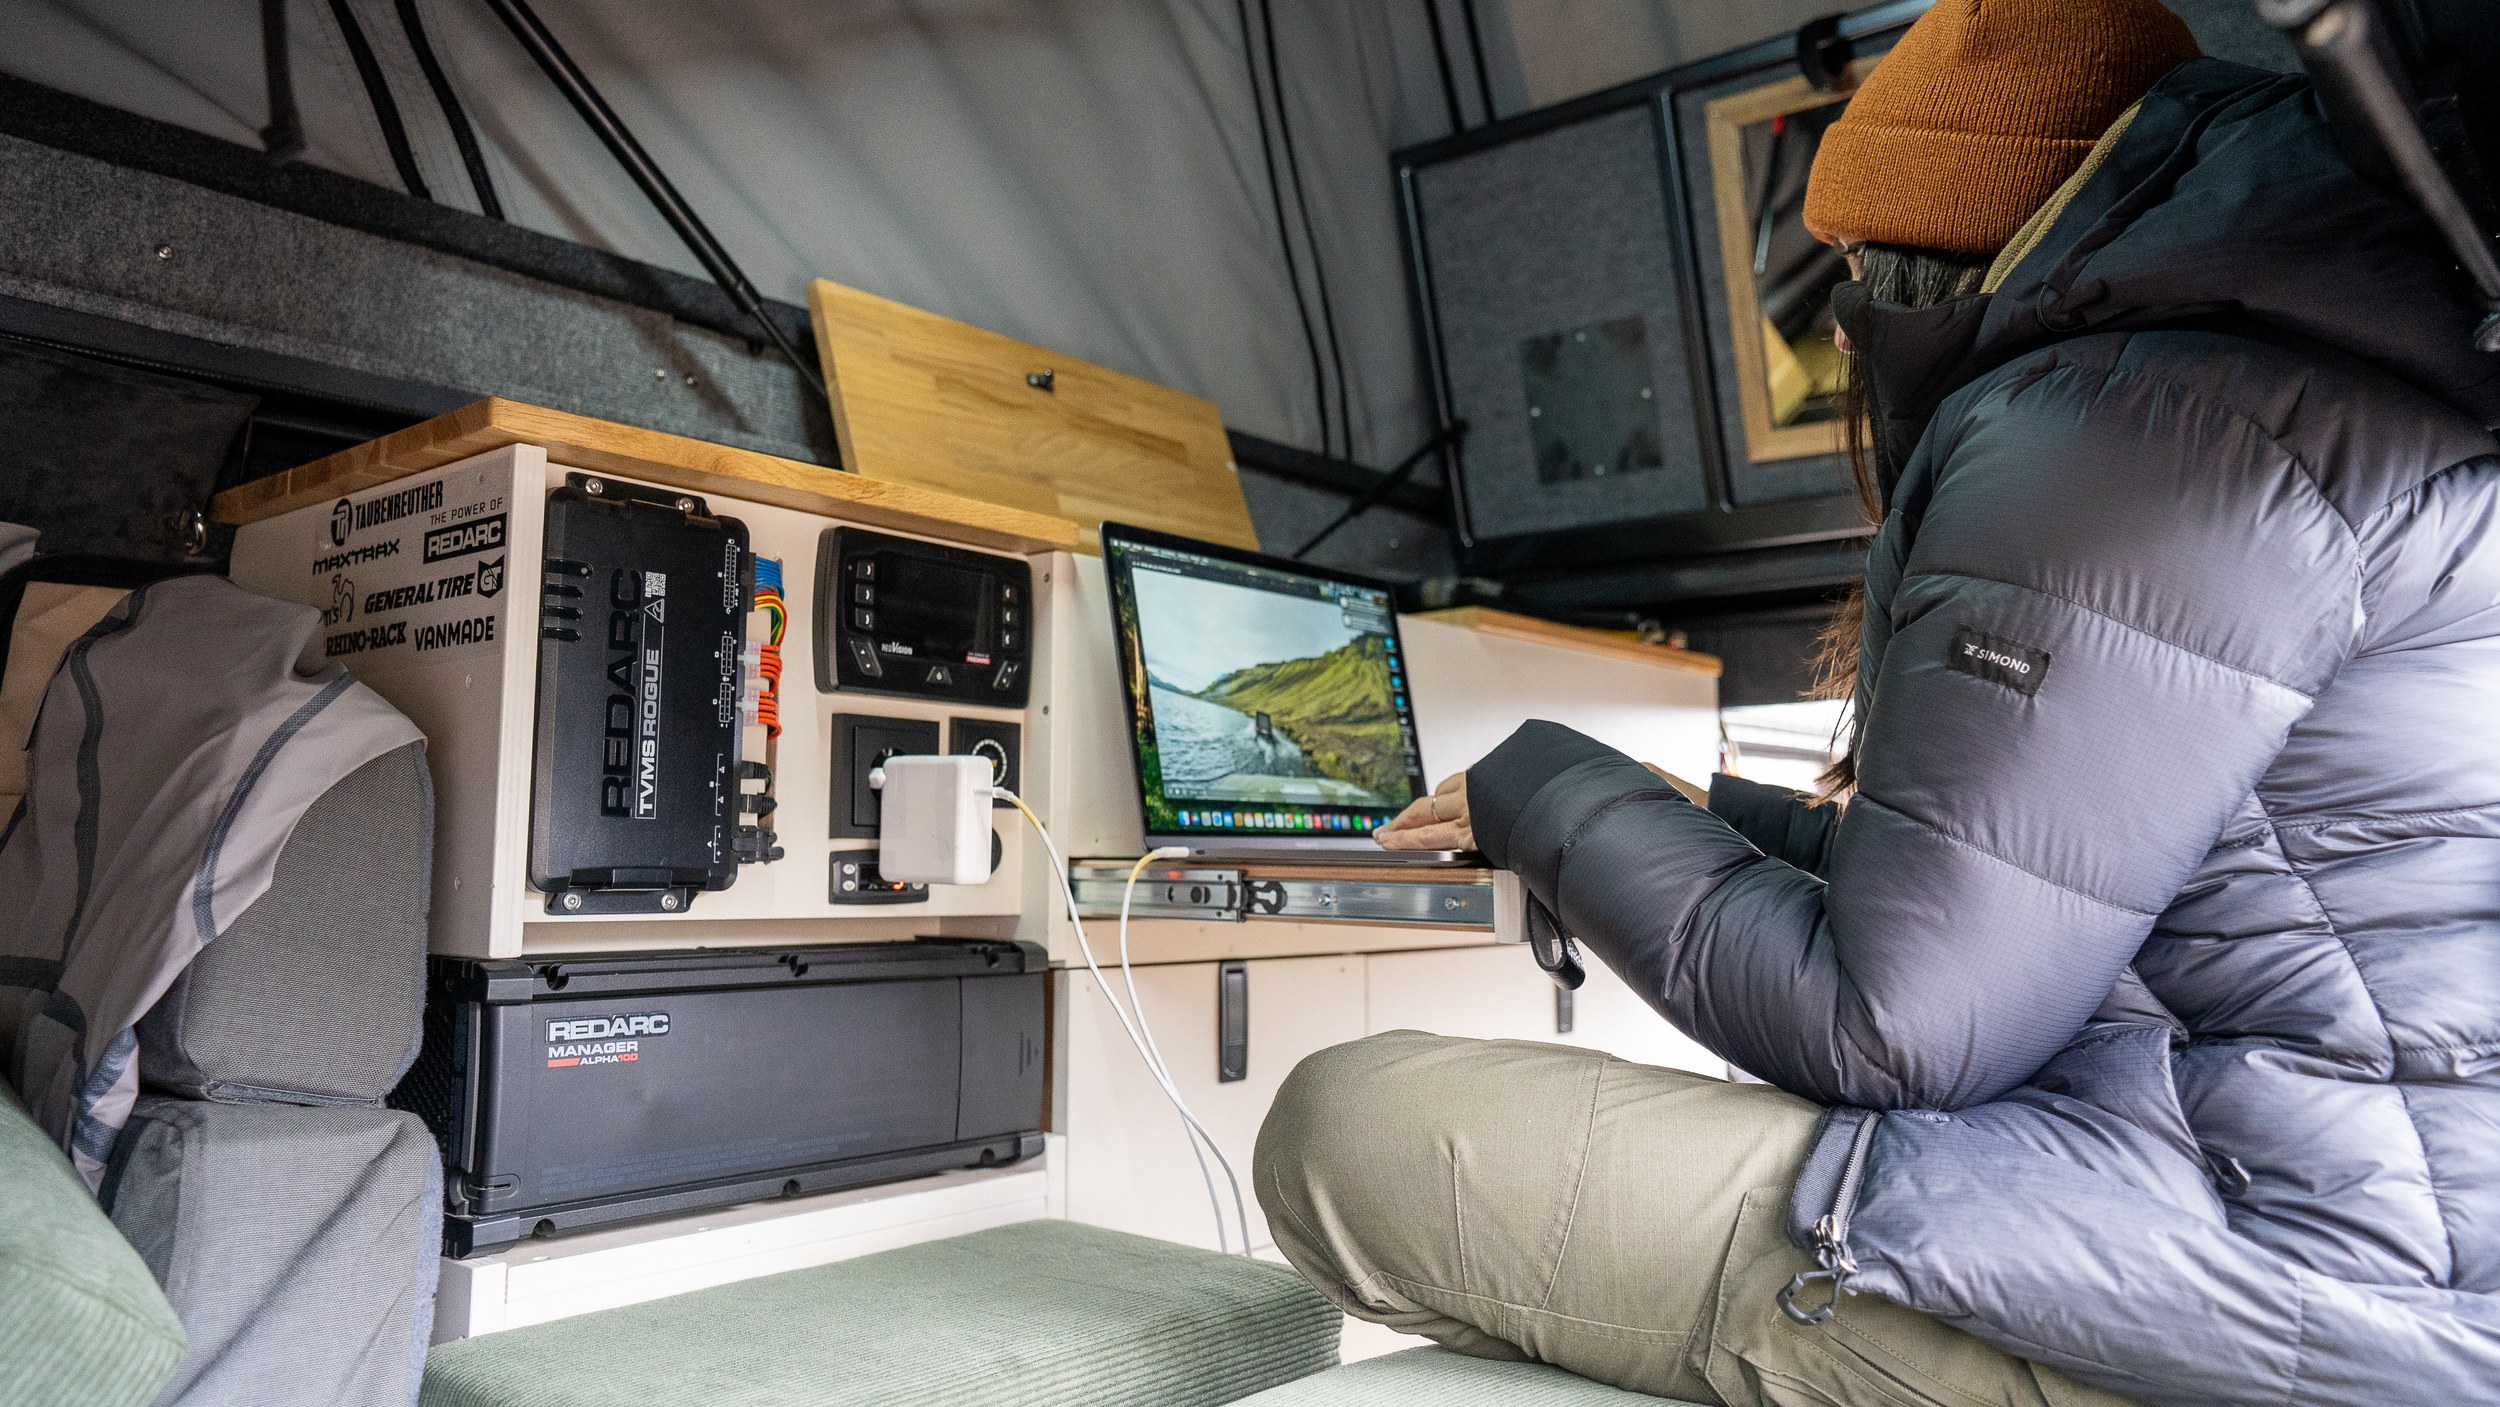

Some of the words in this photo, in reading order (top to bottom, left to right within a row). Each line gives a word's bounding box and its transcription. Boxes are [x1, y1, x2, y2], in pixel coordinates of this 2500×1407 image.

[356, 480, 443, 531] TAUBENREUTHER
[430, 513, 447, 526] THE
[451, 502, 486, 521] POWER
[490, 497, 503, 511] OF
[312, 538, 400, 575] MAXTRAX
[427, 520, 501, 558] REDARC
[364, 581, 434, 614] GENERAL
[437, 572, 475, 601] TIRE
[325, 621, 408, 658] RHINO-RACK
[415, 615, 495, 652] VANMADE
[1977, 648, 2031, 674] SIMOND
[600, 567, 642, 818] REDARC
[642, 648, 660, 737] ROGUE
[639, 739, 656, 815] TVMS
[548, 1014, 669, 1042] REDARC
[548, 1040, 638, 1058] MANAGER
[580, 1053, 639, 1066] ALPHA100
